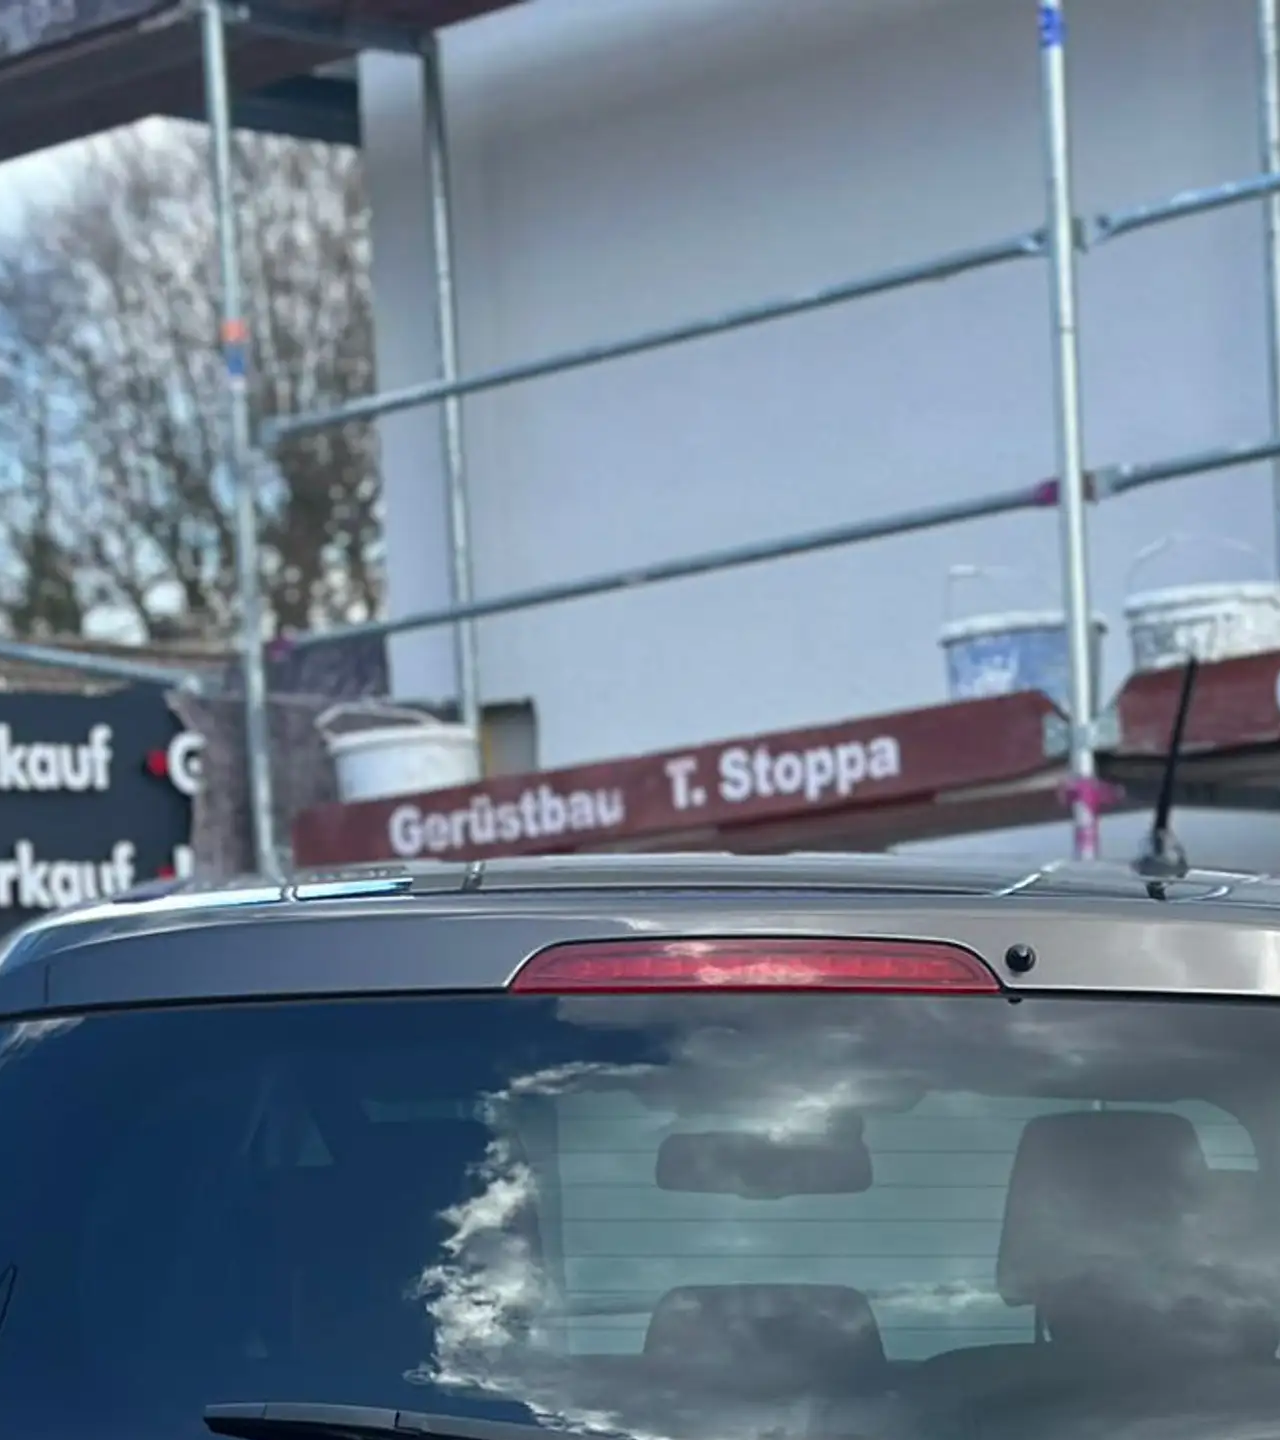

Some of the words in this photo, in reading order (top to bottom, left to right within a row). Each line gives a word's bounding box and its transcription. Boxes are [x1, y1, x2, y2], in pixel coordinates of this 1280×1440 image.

[389, 783, 625, 857] Gerüstbau
[665, 762, 706, 811] T.
[718, 735, 901, 805] Stoppa
